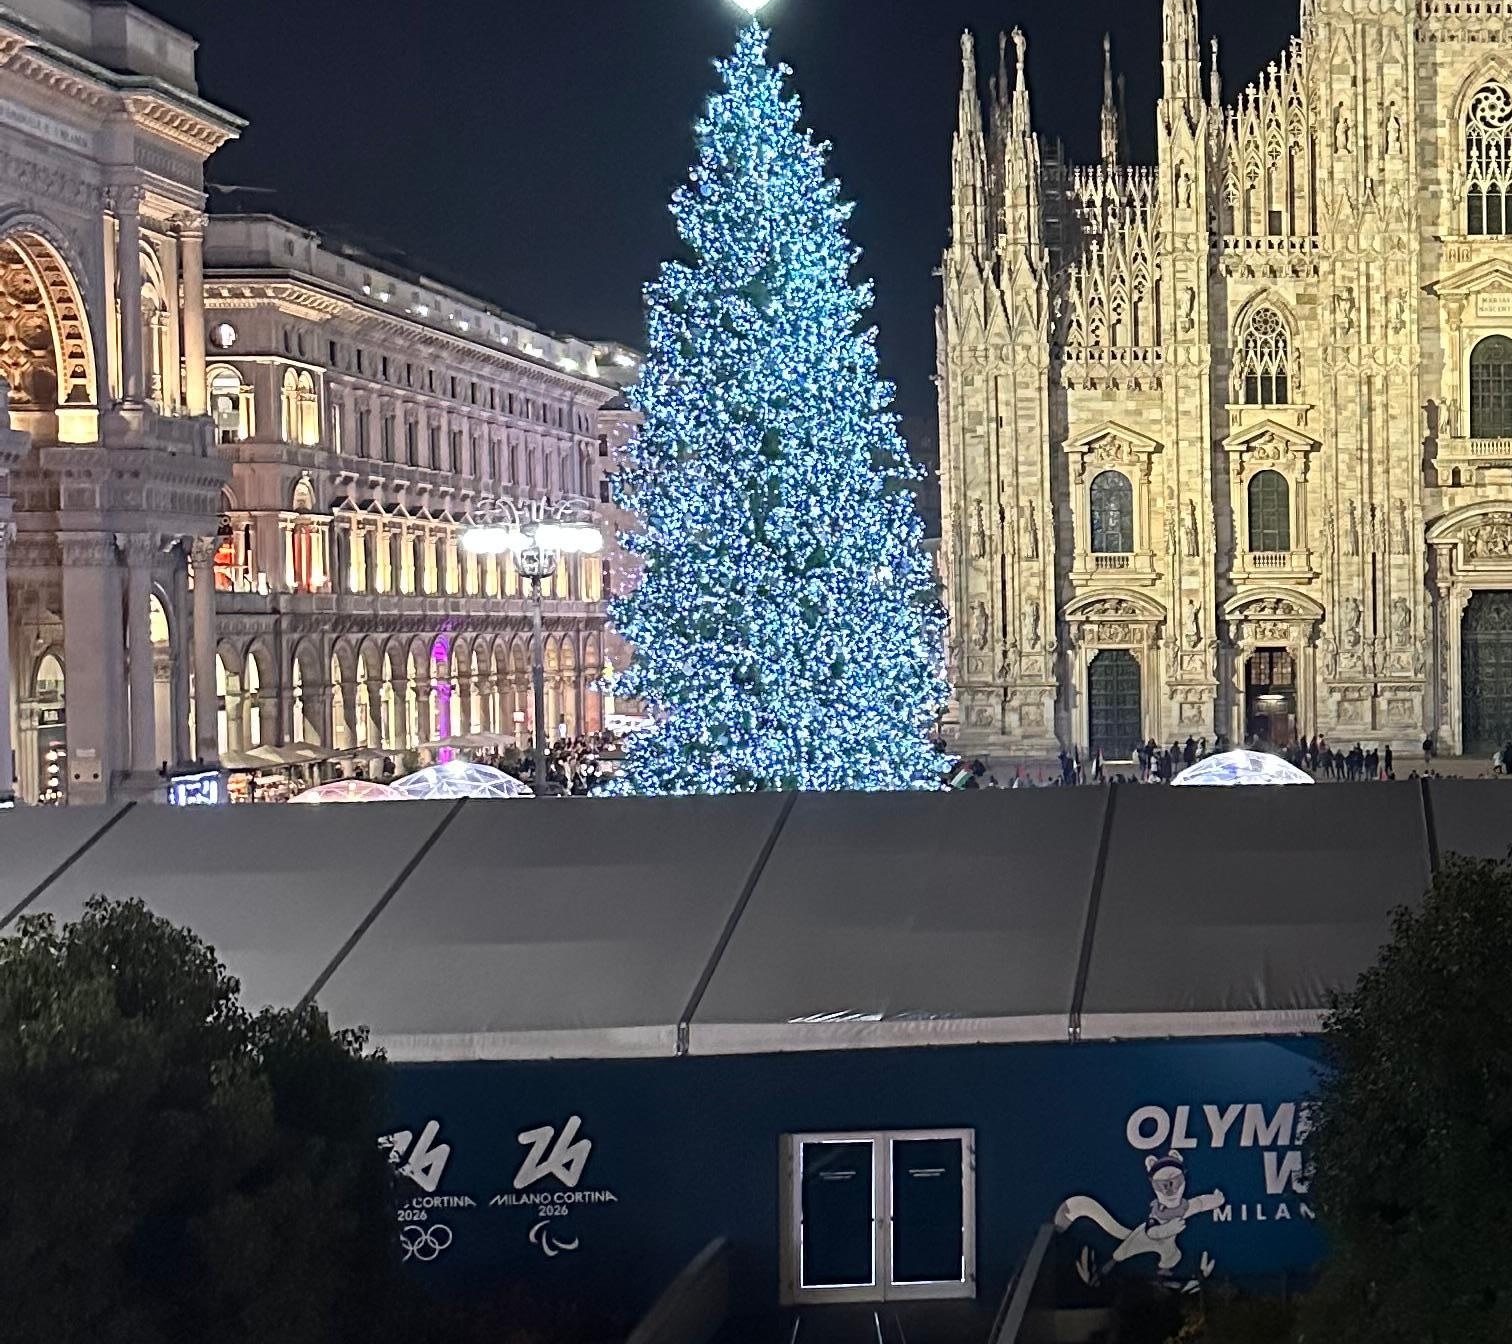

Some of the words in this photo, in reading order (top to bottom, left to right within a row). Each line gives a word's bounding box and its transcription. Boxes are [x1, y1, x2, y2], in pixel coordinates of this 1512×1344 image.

[412, 1196, 477, 1208] CORTINA
[489, 1193, 551, 1206] MILANO
[553, 1190, 619, 1204] CORTINA
[397, 1210, 428, 1222] 2026
[538, 1205, 569, 1217] 2026
